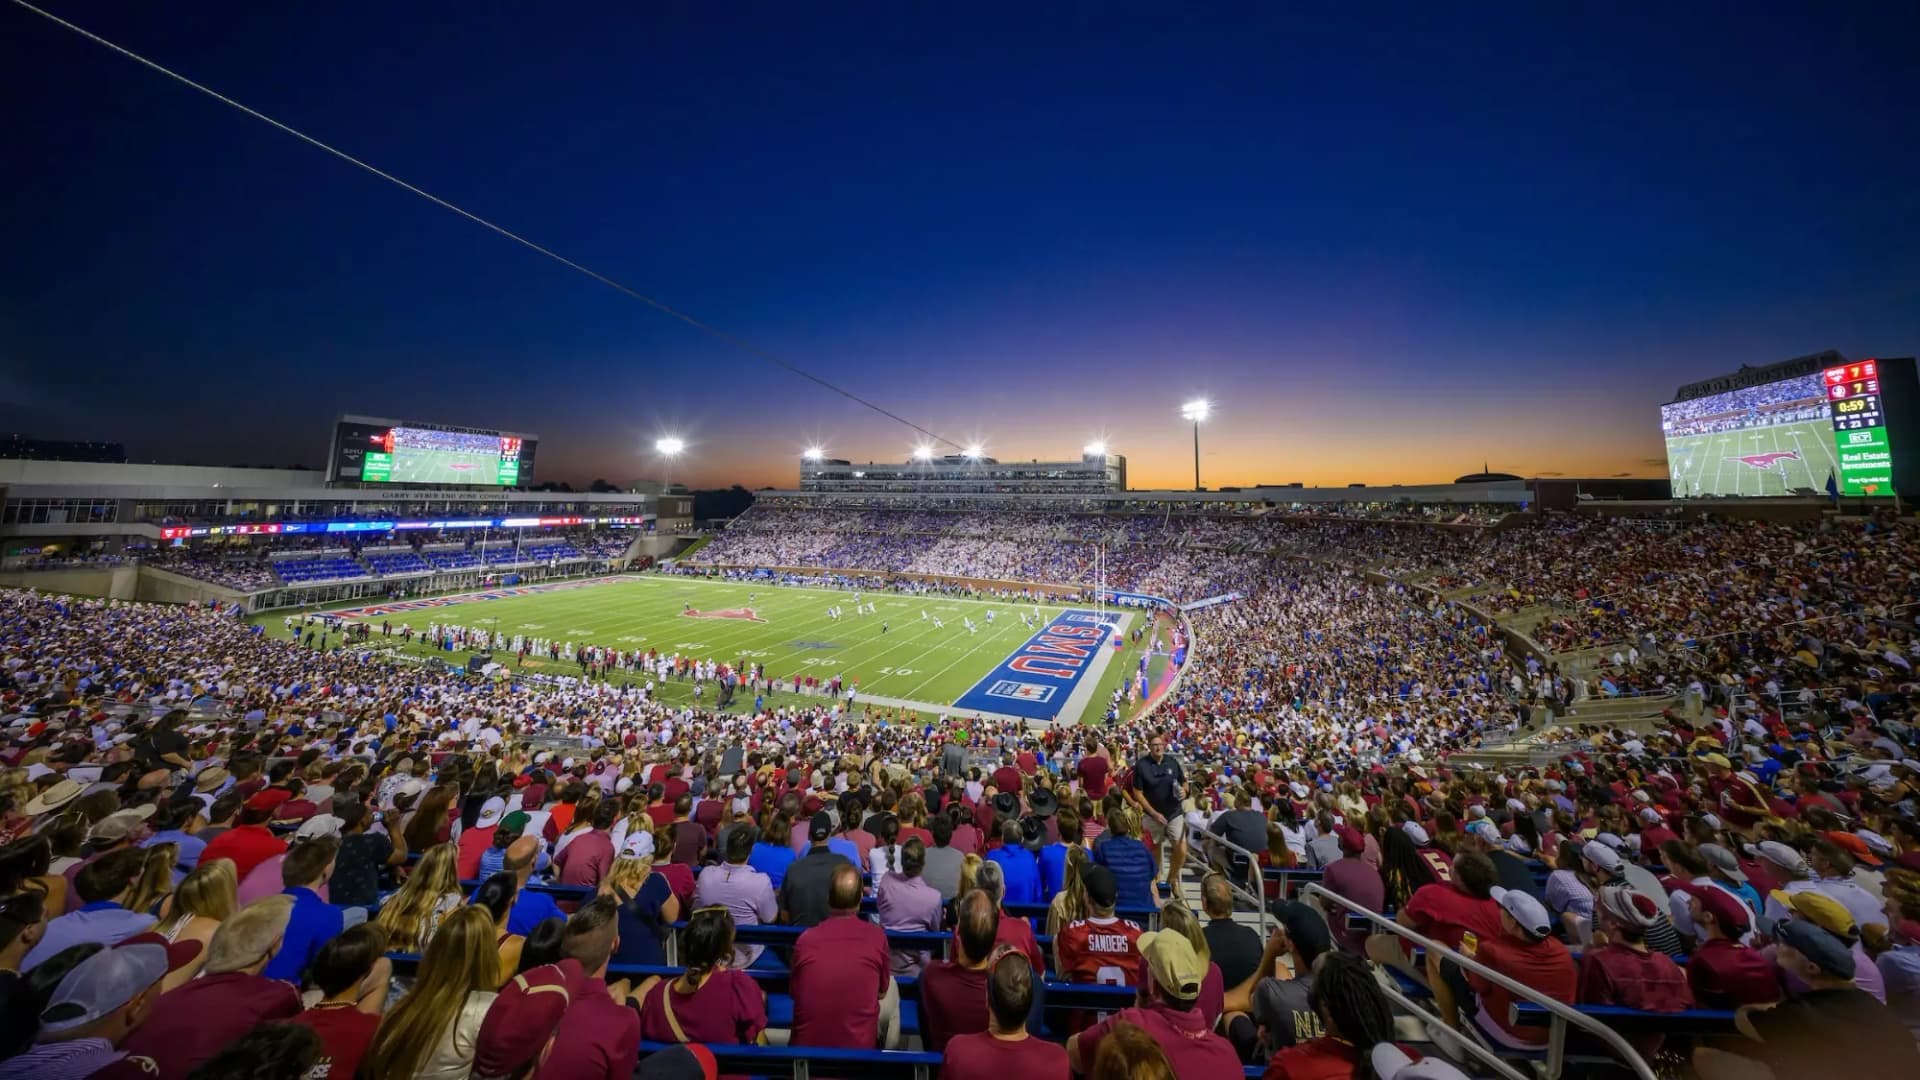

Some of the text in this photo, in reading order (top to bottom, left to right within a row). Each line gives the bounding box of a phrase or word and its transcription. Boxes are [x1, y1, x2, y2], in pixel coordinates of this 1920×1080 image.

[1851, 367, 1859, 377] 7
[1854, 383, 1862, 393] 7
[1839, 400, 1865, 412] 0:59
[1842, 452, 1890, 461] Real Estate
[1841, 461, 1891, 470] Investments
[1007, 625, 1105, 680] SMU
[1424, 852, 1451, 881] 5
[1088, 934, 1129, 953] SANDERS
